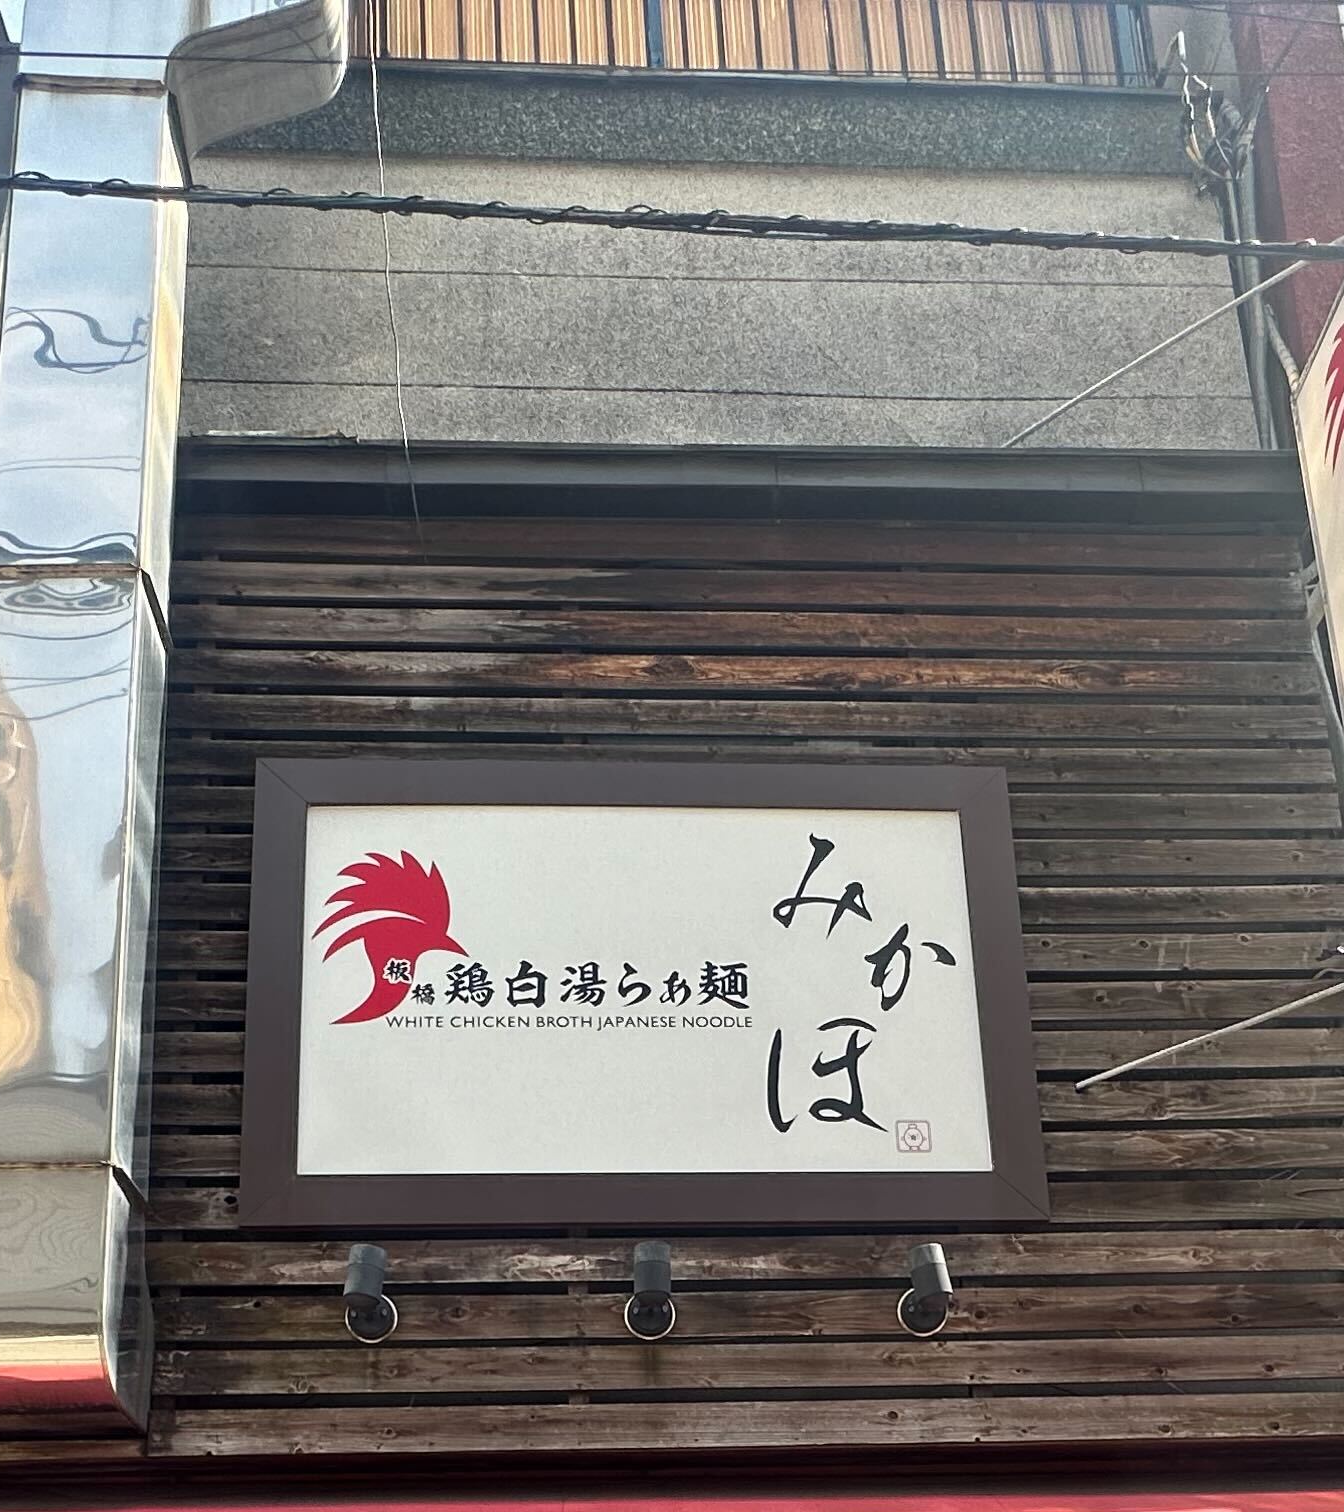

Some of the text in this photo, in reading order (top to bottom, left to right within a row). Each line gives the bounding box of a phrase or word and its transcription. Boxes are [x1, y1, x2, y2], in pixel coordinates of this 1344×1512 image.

[385, 959, 750, 1010] 板橋 鶏白湯らぁ麺
[767, 833, 957, 1134] みかほ
[386, 1016, 753, 1031] WHITE CHICKEN BROTH JAPANESE NOODLE
